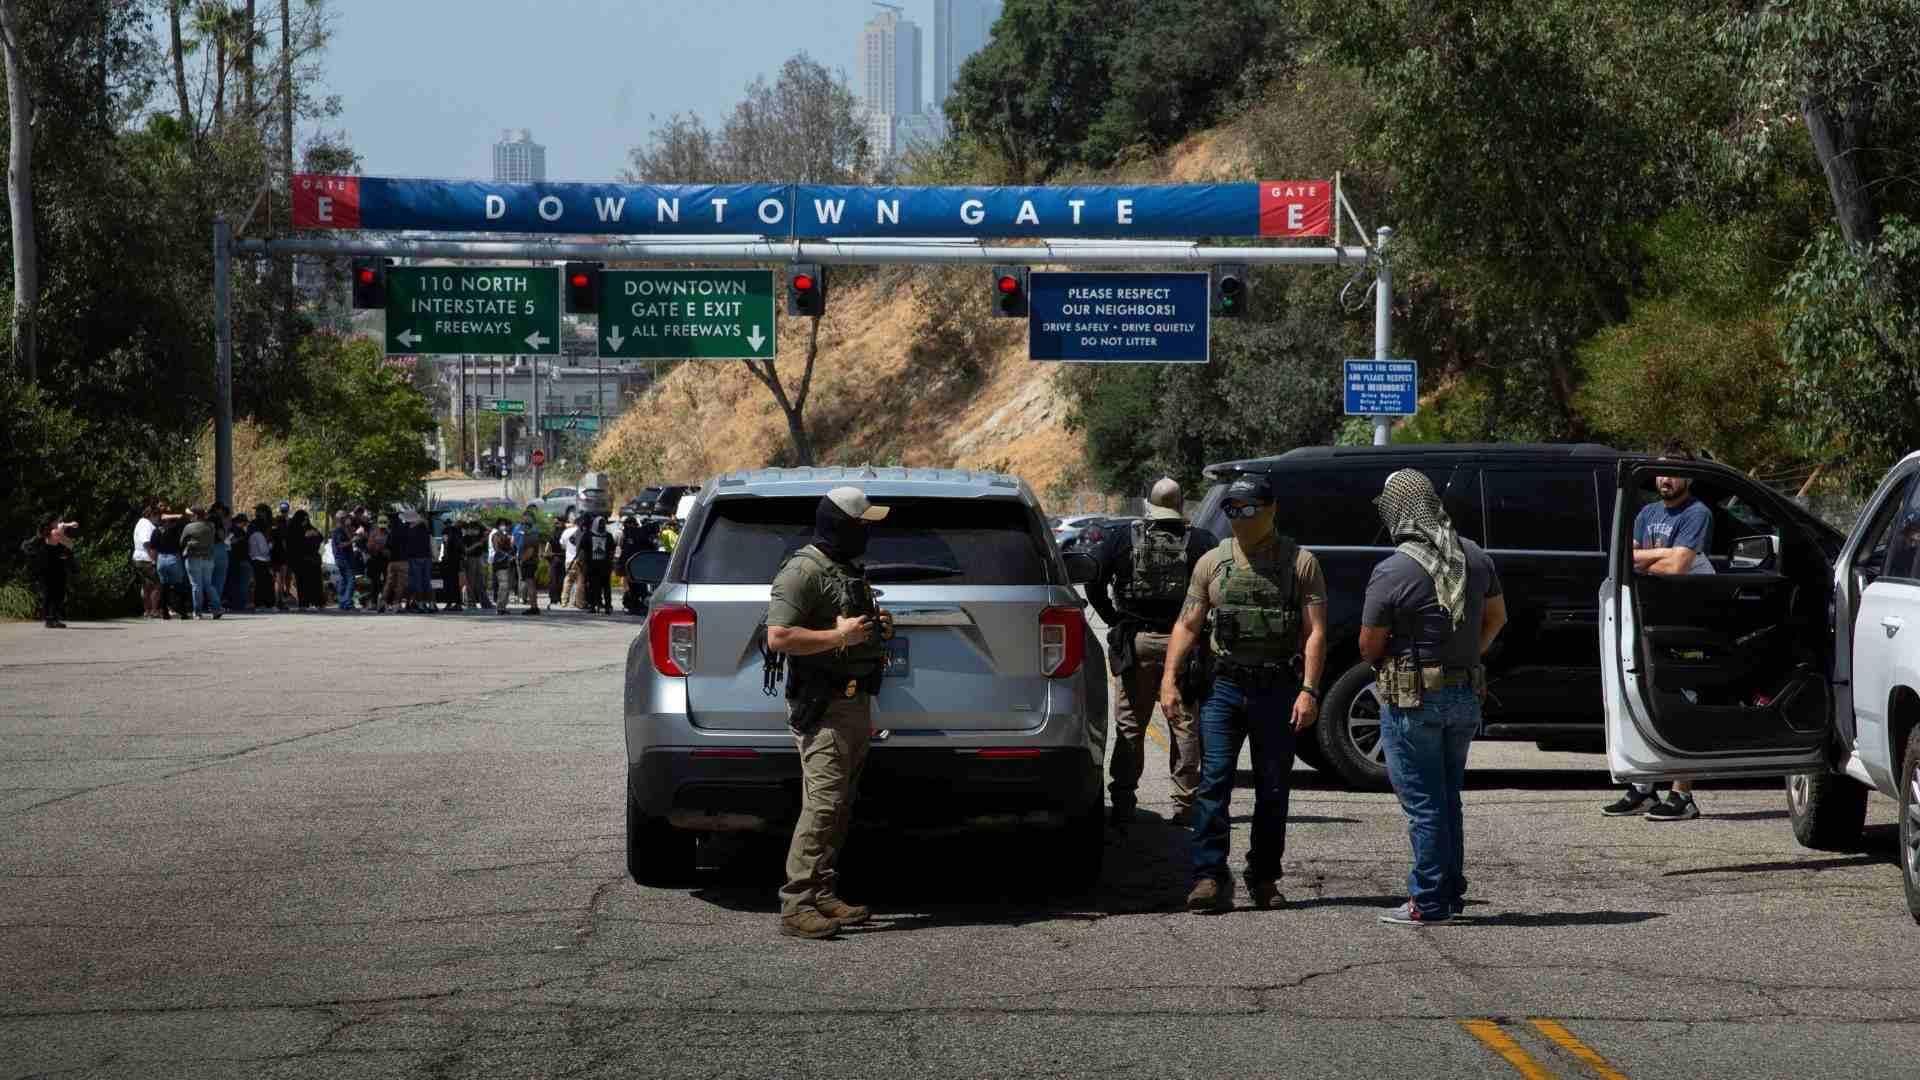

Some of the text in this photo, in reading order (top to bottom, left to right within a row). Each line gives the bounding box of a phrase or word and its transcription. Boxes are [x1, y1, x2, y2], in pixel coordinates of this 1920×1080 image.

[302, 180, 345, 191] GATE
[1271, 187, 1317, 197] GATE
[318, 196, 333, 221] E
[485, 194, 1134, 225] DOWNTOWN GATE
[1287, 203, 1304, 230] E
[419, 276, 528, 292] 110 NORTH
[624, 280, 747, 295] DOWNTOWN
[1068, 288, 1171, 299] PLEASE RESPECT
[411, 298, 535, 315] INTERSTATE 5
[631, 302, 742, 317] GATE E EXIT
[1062, 304, 1176, 315] OUR NEIGHBORS!
[435, 321, 512, 334] FREEWAYS
[632, 324, 741, 337] ALL FREEWAYS
[1043, 323, 1195, 333] DRIVE SAFELY DRIVE QUIETLY
[1081, 337, 1158, 346] DO NOT LITTER
